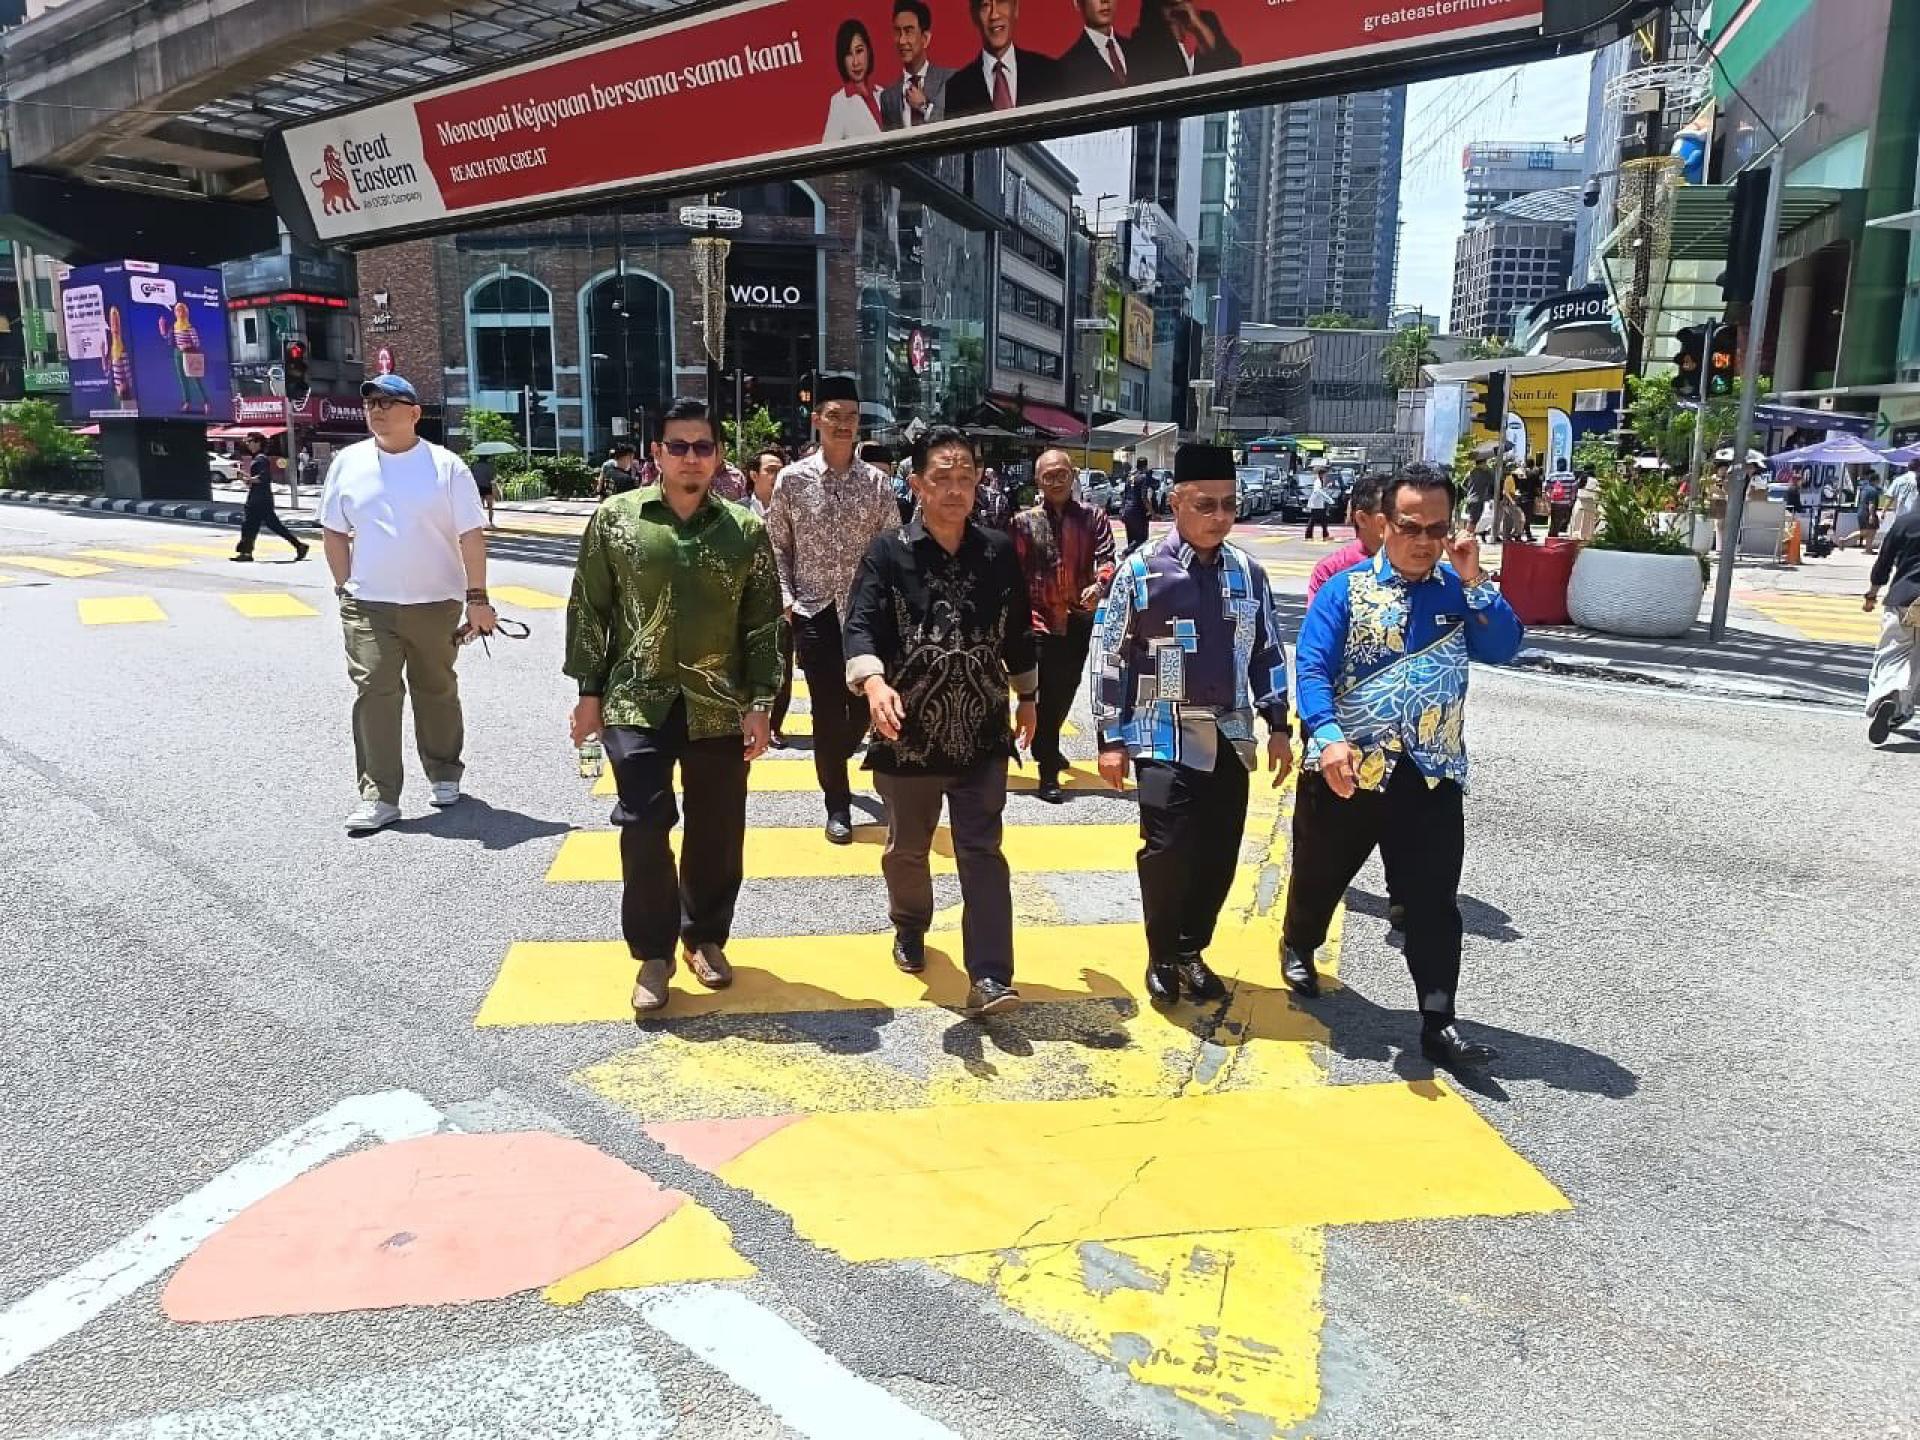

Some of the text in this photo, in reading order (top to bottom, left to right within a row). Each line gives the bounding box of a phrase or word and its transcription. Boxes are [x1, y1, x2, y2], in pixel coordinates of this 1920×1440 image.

[436, 30, 803, 147] Mencapai Kejayaan bersama-sama kami
[342, 132, 392, 166] Great
[450, 147, 548, 183] REACH FOR GREAT
[351, 162, 418, 193] Eastern
[730, 285, 800, 304] WOLO
[1513, 388, 1558, 400] Sun Life
